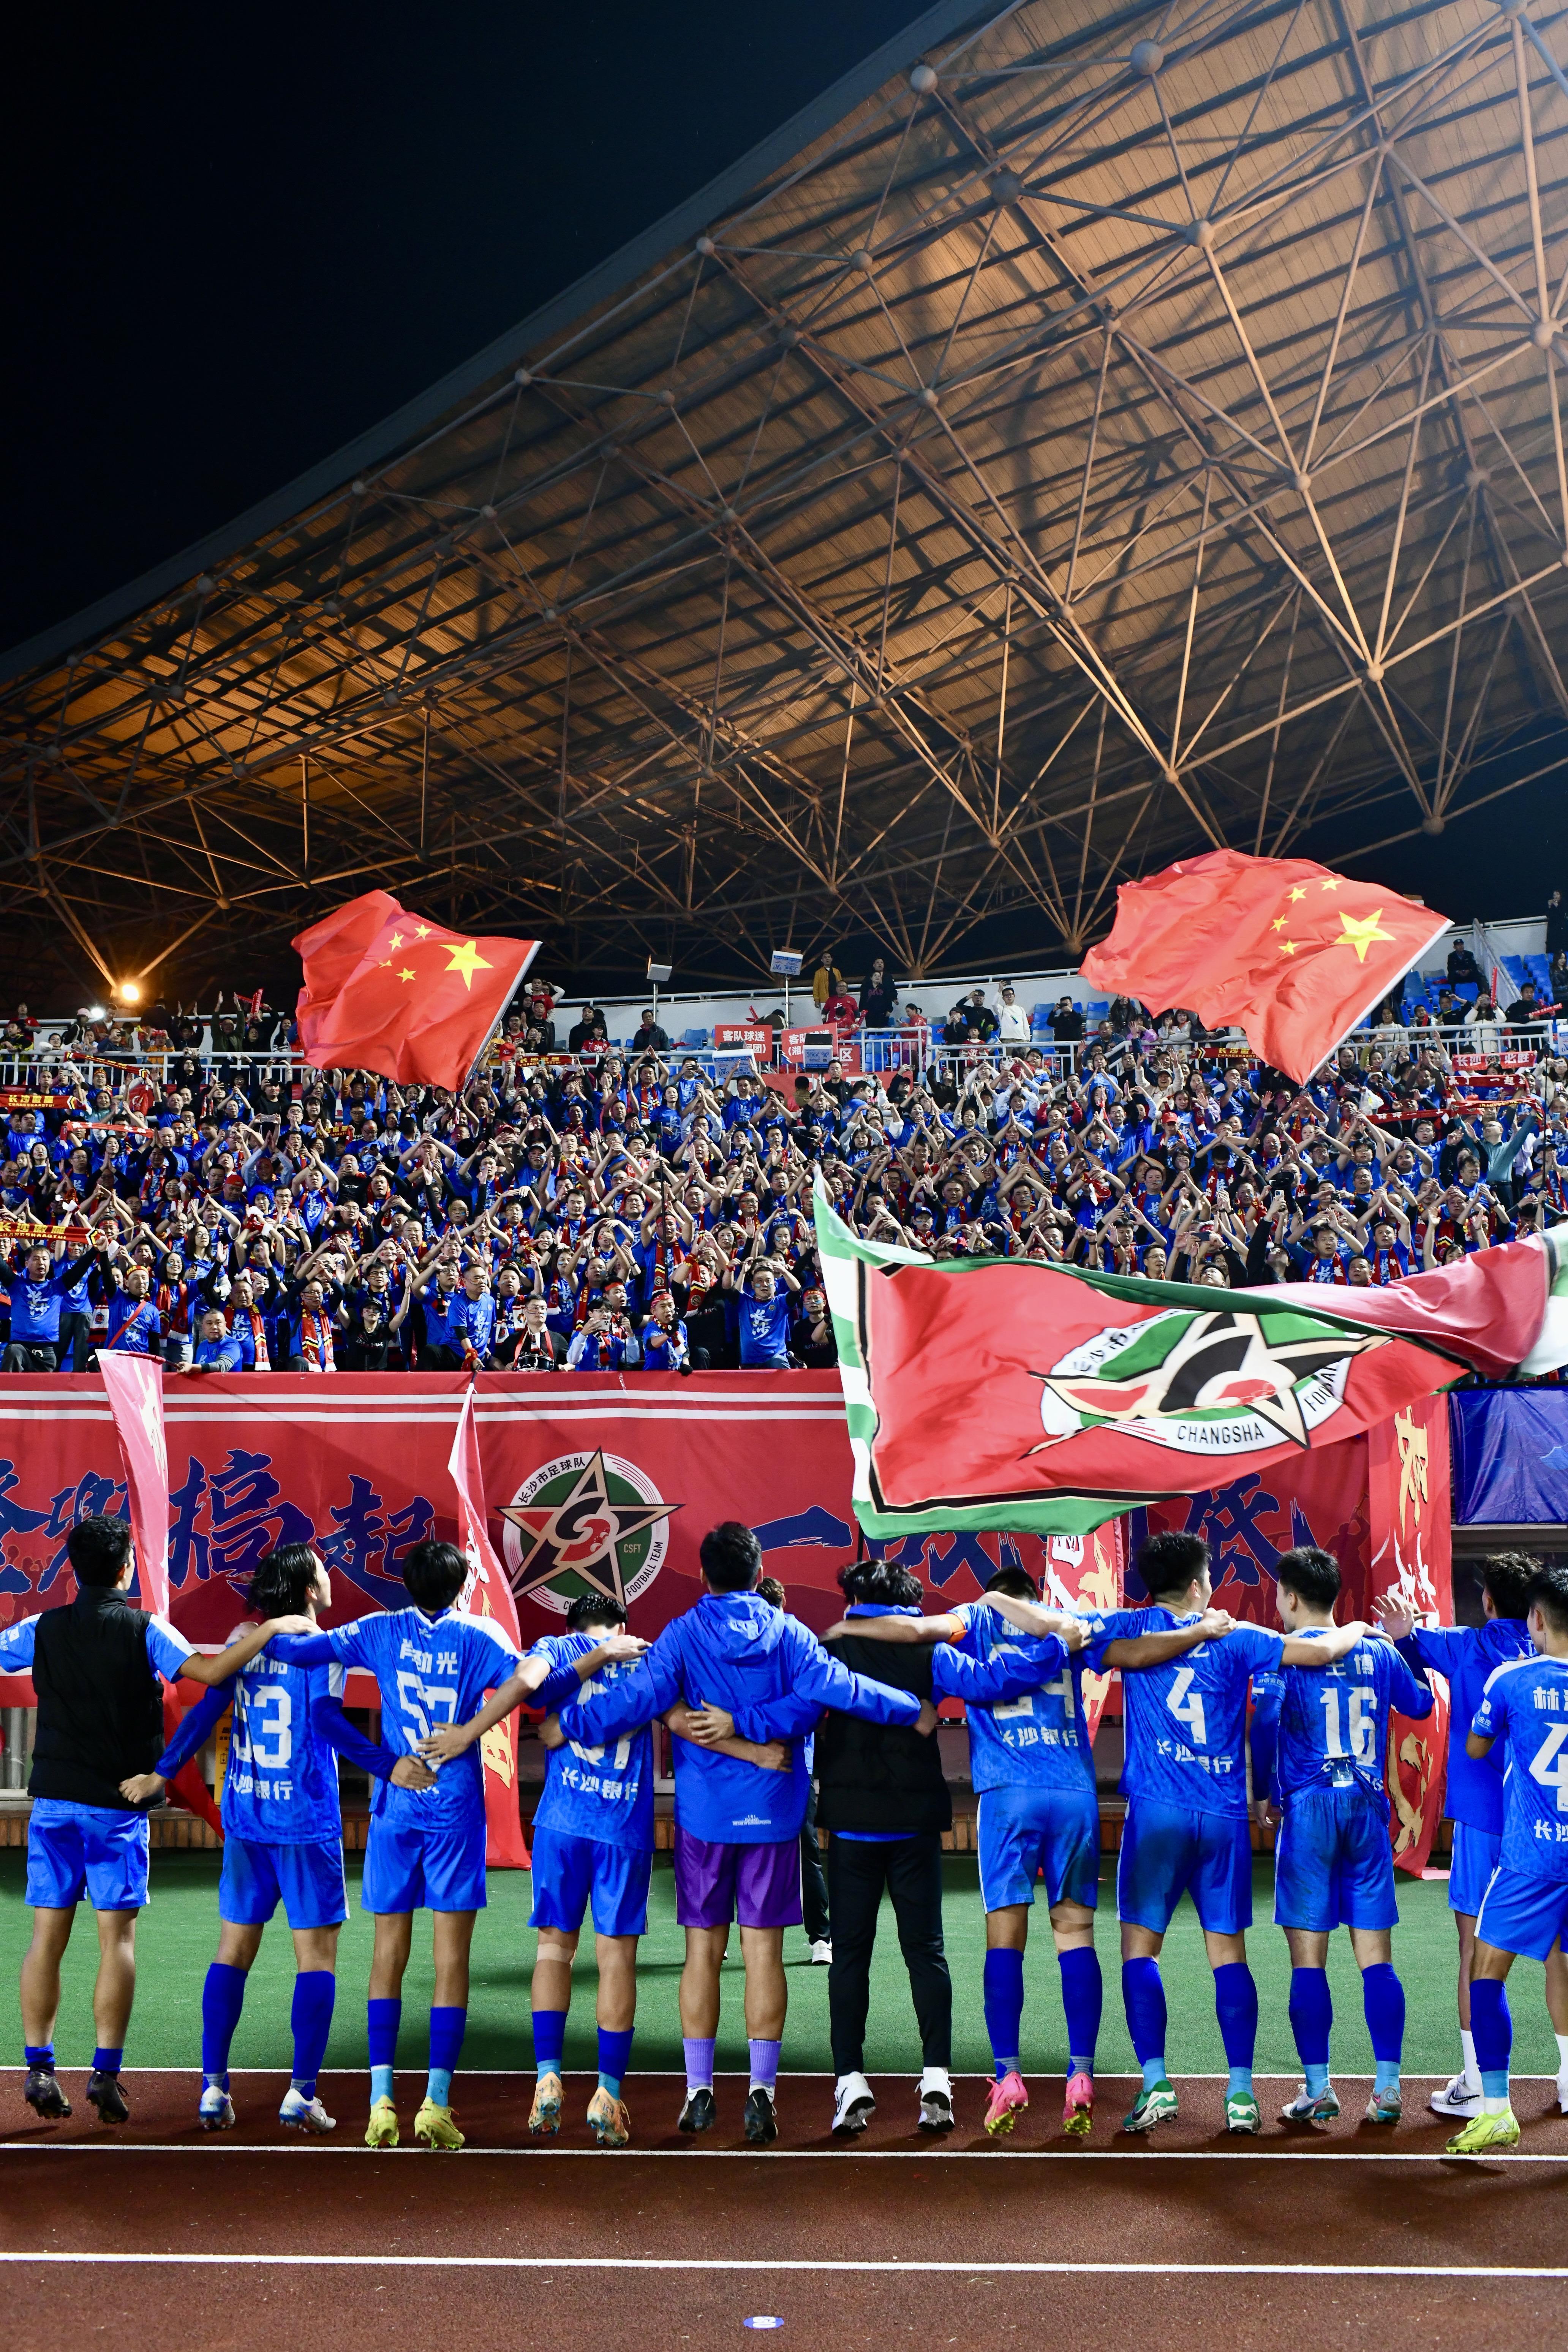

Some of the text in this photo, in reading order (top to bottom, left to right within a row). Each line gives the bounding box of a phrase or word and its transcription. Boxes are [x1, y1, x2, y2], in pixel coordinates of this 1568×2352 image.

[723, 1031, 765, 1042] 客队球迷
[1457, 1053, 1529, 1067] 长沙 必胜
[667, 1116, 681, 1142] 长沙
[308, 1197, 322, 1219] 长沙
[980, 1195, 997, 1220] 长沙
[28, 1291, 50, 1320] 长沙
[232, 1314, 251, 1341] 长沙
[474, 1312, 491, 1347] 长沙
[751, 1309, 773, 1340] 长沙
[1178, 1422, 1265, 1444] CHANGSHA
[518, 1456, 585, 1503] 长沙市足球队
[624, 1544, 642, 1553] CSFT
[626, 1541, 663, 1596] FOOTBALL TEAM
[1166, 1666, 1207, 1745] 4
[1003, 1726, 1079, 1747] 长沙银行
[1320, 1687, 1378, 1768] 16
[561, 1767, 639, 1801] 长沙银行
